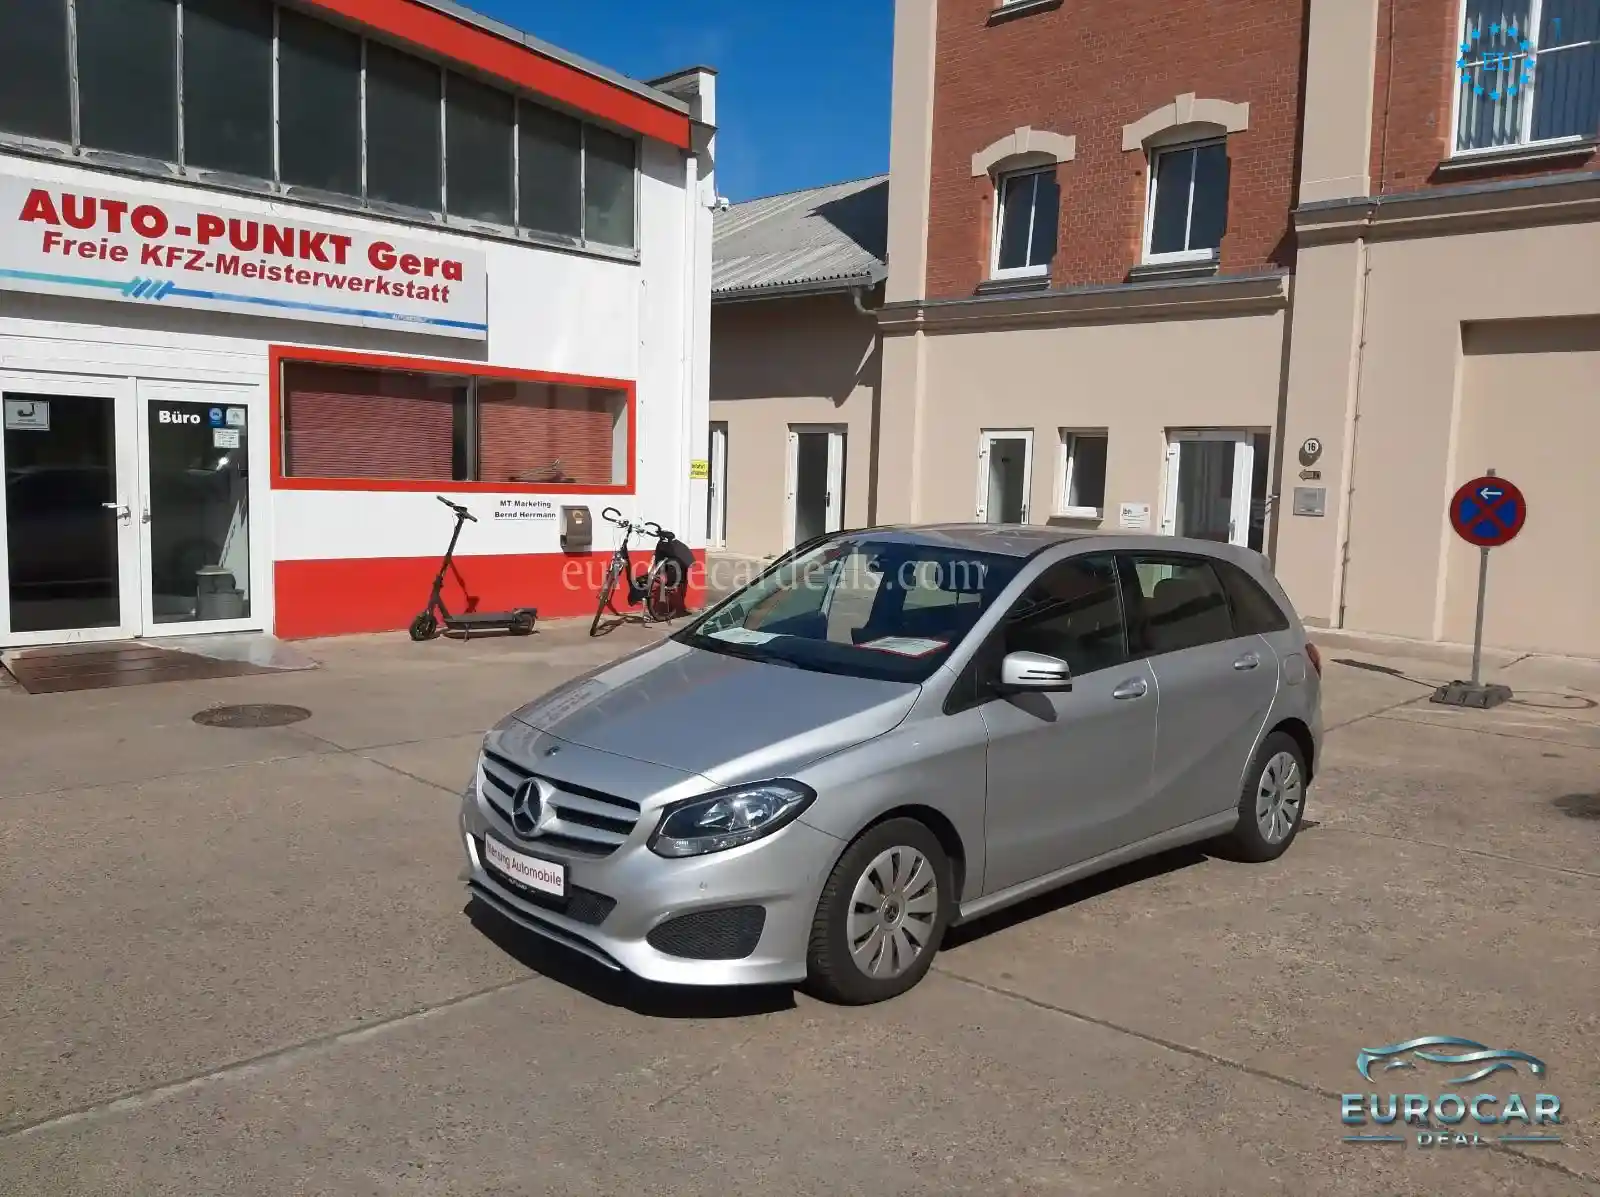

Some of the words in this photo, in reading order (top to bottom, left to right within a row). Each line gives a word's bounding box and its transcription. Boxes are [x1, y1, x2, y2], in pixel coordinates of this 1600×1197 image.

[19, 187, 353, 266] AUTO-PUNKT
[367, 240, 465, 282] Gera
[41, 230, 129, 263] Freie
[139, 242, 451, 304] KFZ-Meisterwerkstatt
[158, 409, 201, 425] Büro
[1307, 442, 1316, 452] 16
[514, 500, 552, 508] Marketing
[511, 857, 562, 886] Automobile
